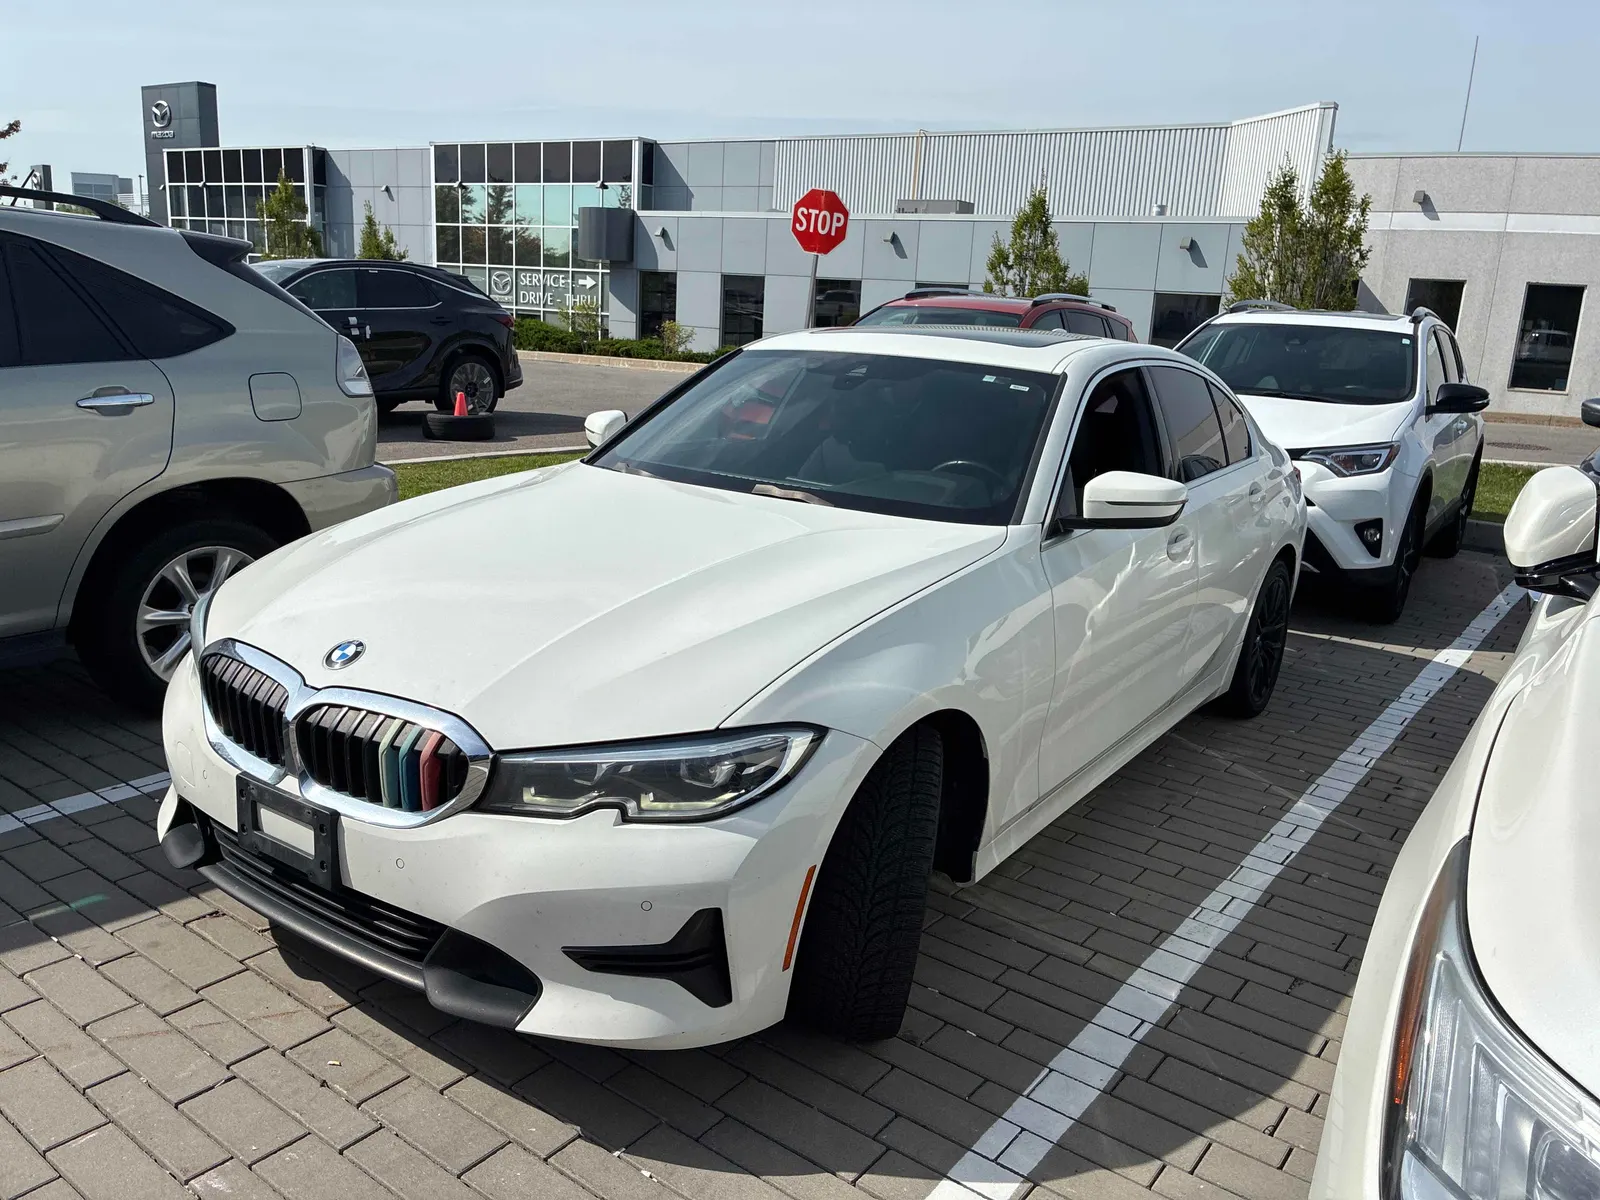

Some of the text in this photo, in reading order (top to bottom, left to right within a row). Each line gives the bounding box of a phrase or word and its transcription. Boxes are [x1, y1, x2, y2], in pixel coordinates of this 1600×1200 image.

[795, 206, 845, 237] STOP
[520, 272, 566, 288] SERVICE
[520, 290, 554, 305] DRIVE
[564, 293, 597, 308] THRU
